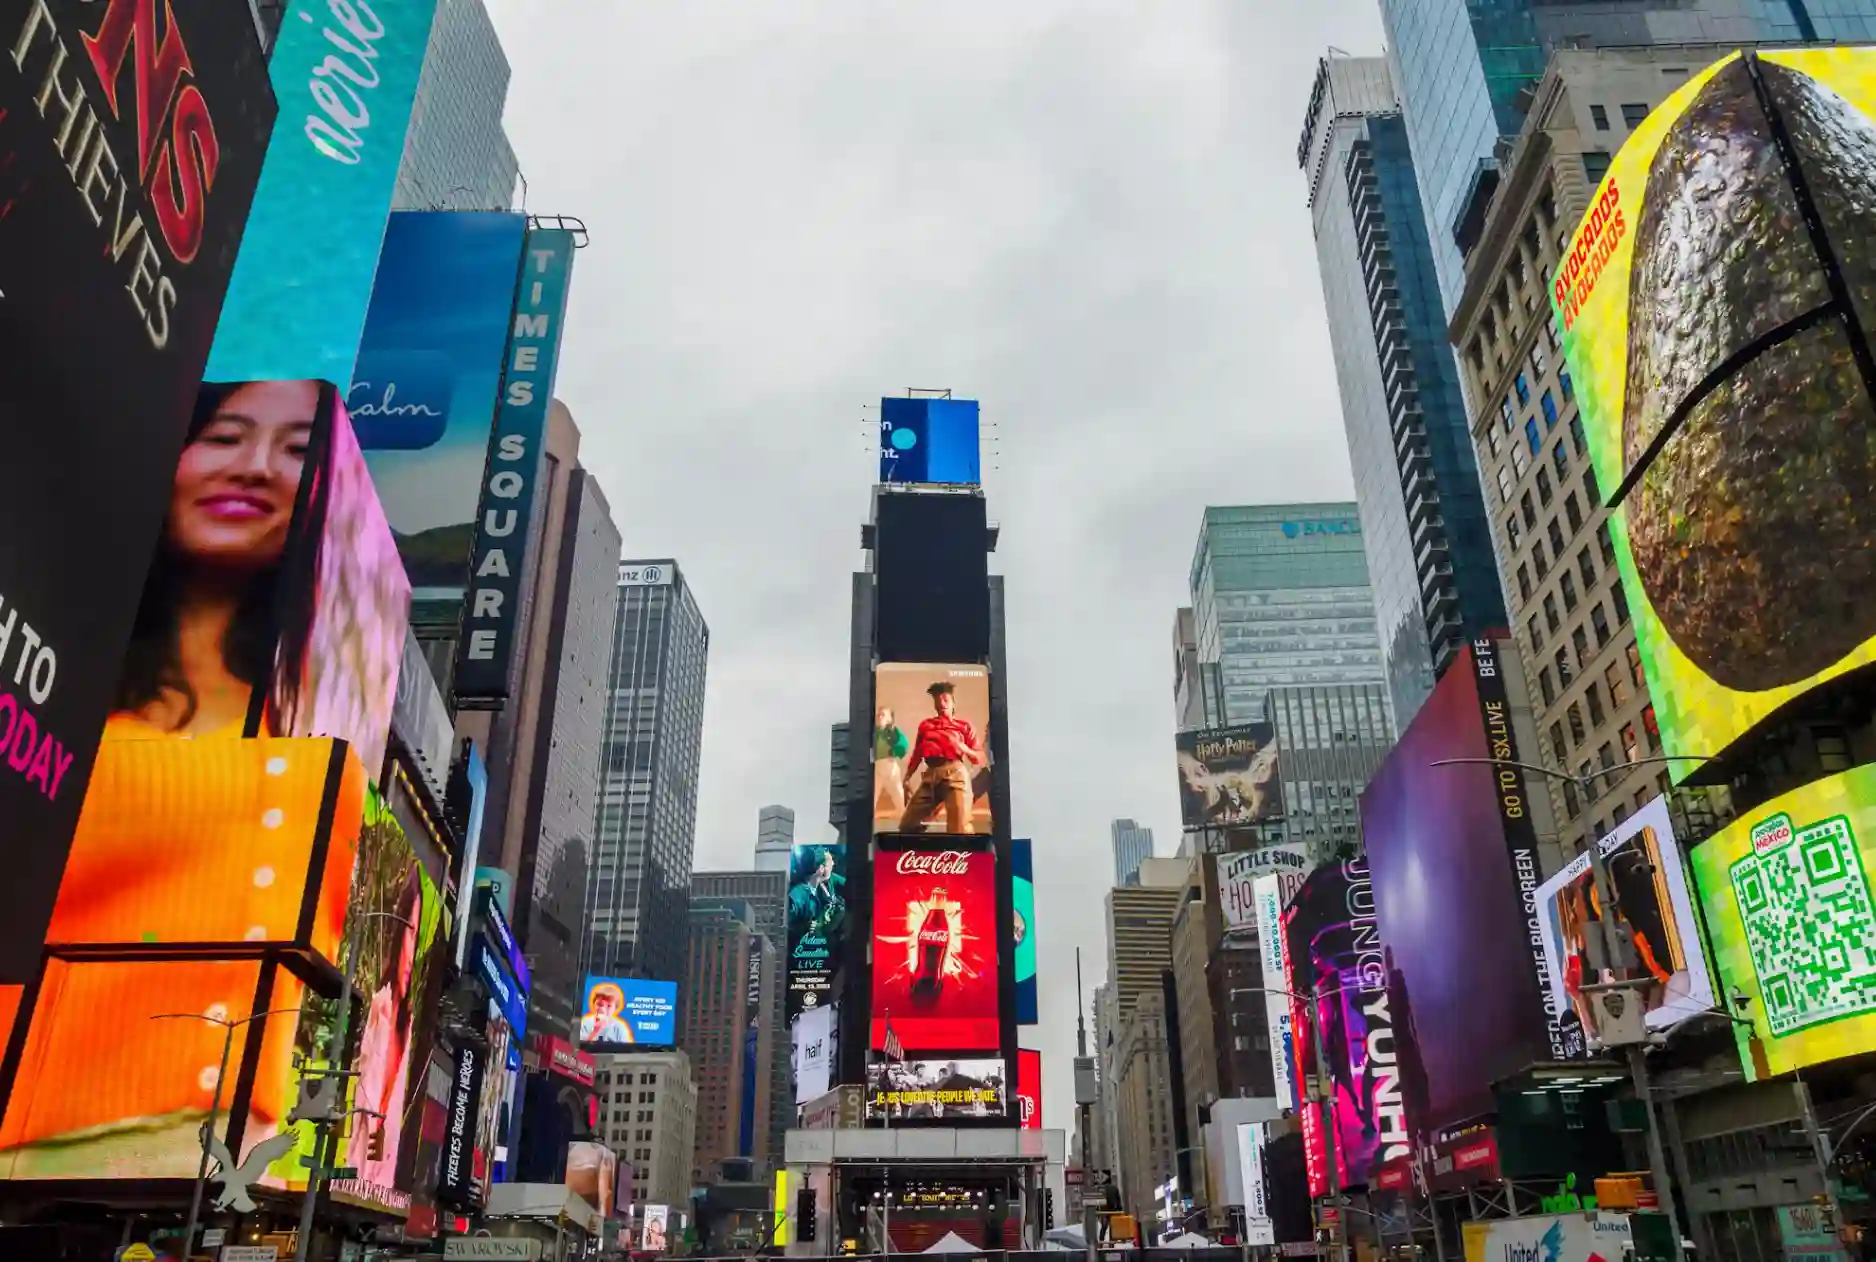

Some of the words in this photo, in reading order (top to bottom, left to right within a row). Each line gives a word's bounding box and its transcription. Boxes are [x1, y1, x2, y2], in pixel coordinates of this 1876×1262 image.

[1555, 177, 1620, 307] AVOCADOS
[1563, 209, 1627, 332] AVOCADOS
[506, 249, 555, 406] TIMES
[467, 434, 524, 660] SQUARE
[14, 621, 57, 705] TO
[1478, 656, 1496, 677] BE
[1499, 770, 1517, 792] TO
[1504, 795, 1523, 819] GO
[896, 849, 973, 875] Coca-Cola
[1227, 850, 1270, 880] LITTLE
[1271, 850, 1306, 869] SHOP
[1341, 855, 1388, 994] JUNG
[798, 959, 825, 969] LIVE
[464, 1048, 475, 1092] HEROES
[451, 1095, 469, 1136] BECOME
[445, 1136, 463, 1189] THIEVES
[1593, 1220, 1629, 1233] United
